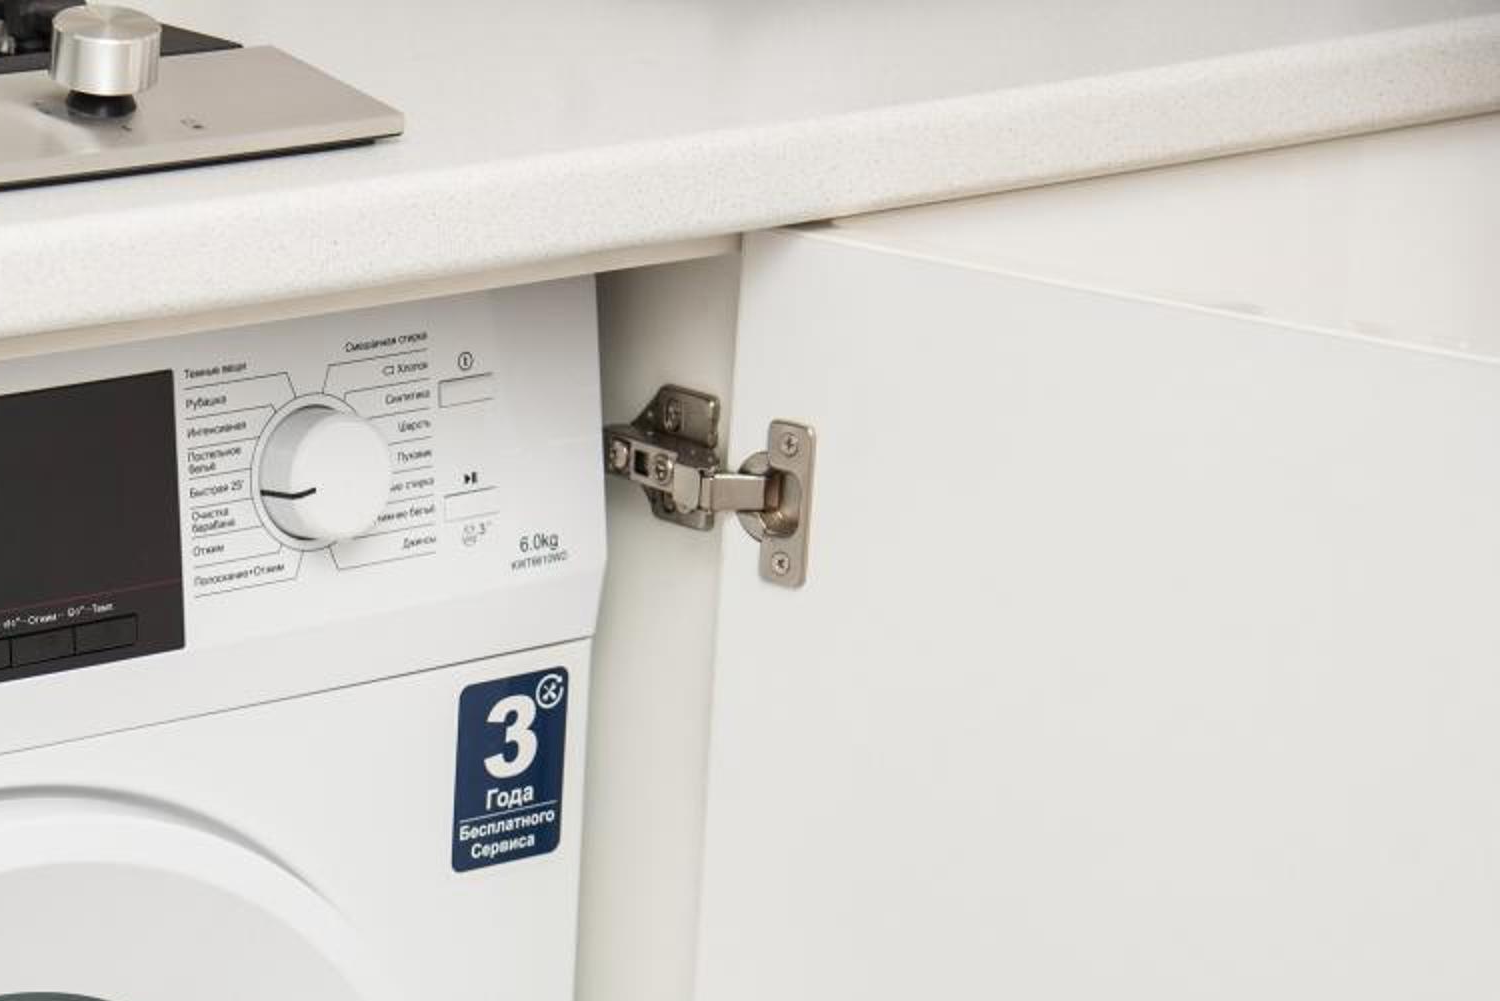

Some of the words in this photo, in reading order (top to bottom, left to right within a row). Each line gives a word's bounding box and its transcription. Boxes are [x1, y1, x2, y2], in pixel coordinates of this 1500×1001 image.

[519, 532, 560, 552] 6.0kg
[484, 694, 538, 778] 3
[486, 785, 534, 810] Года
[459, 809, 555, 841] Бесплатного
[471, 833, 535, 859] Сервиса
